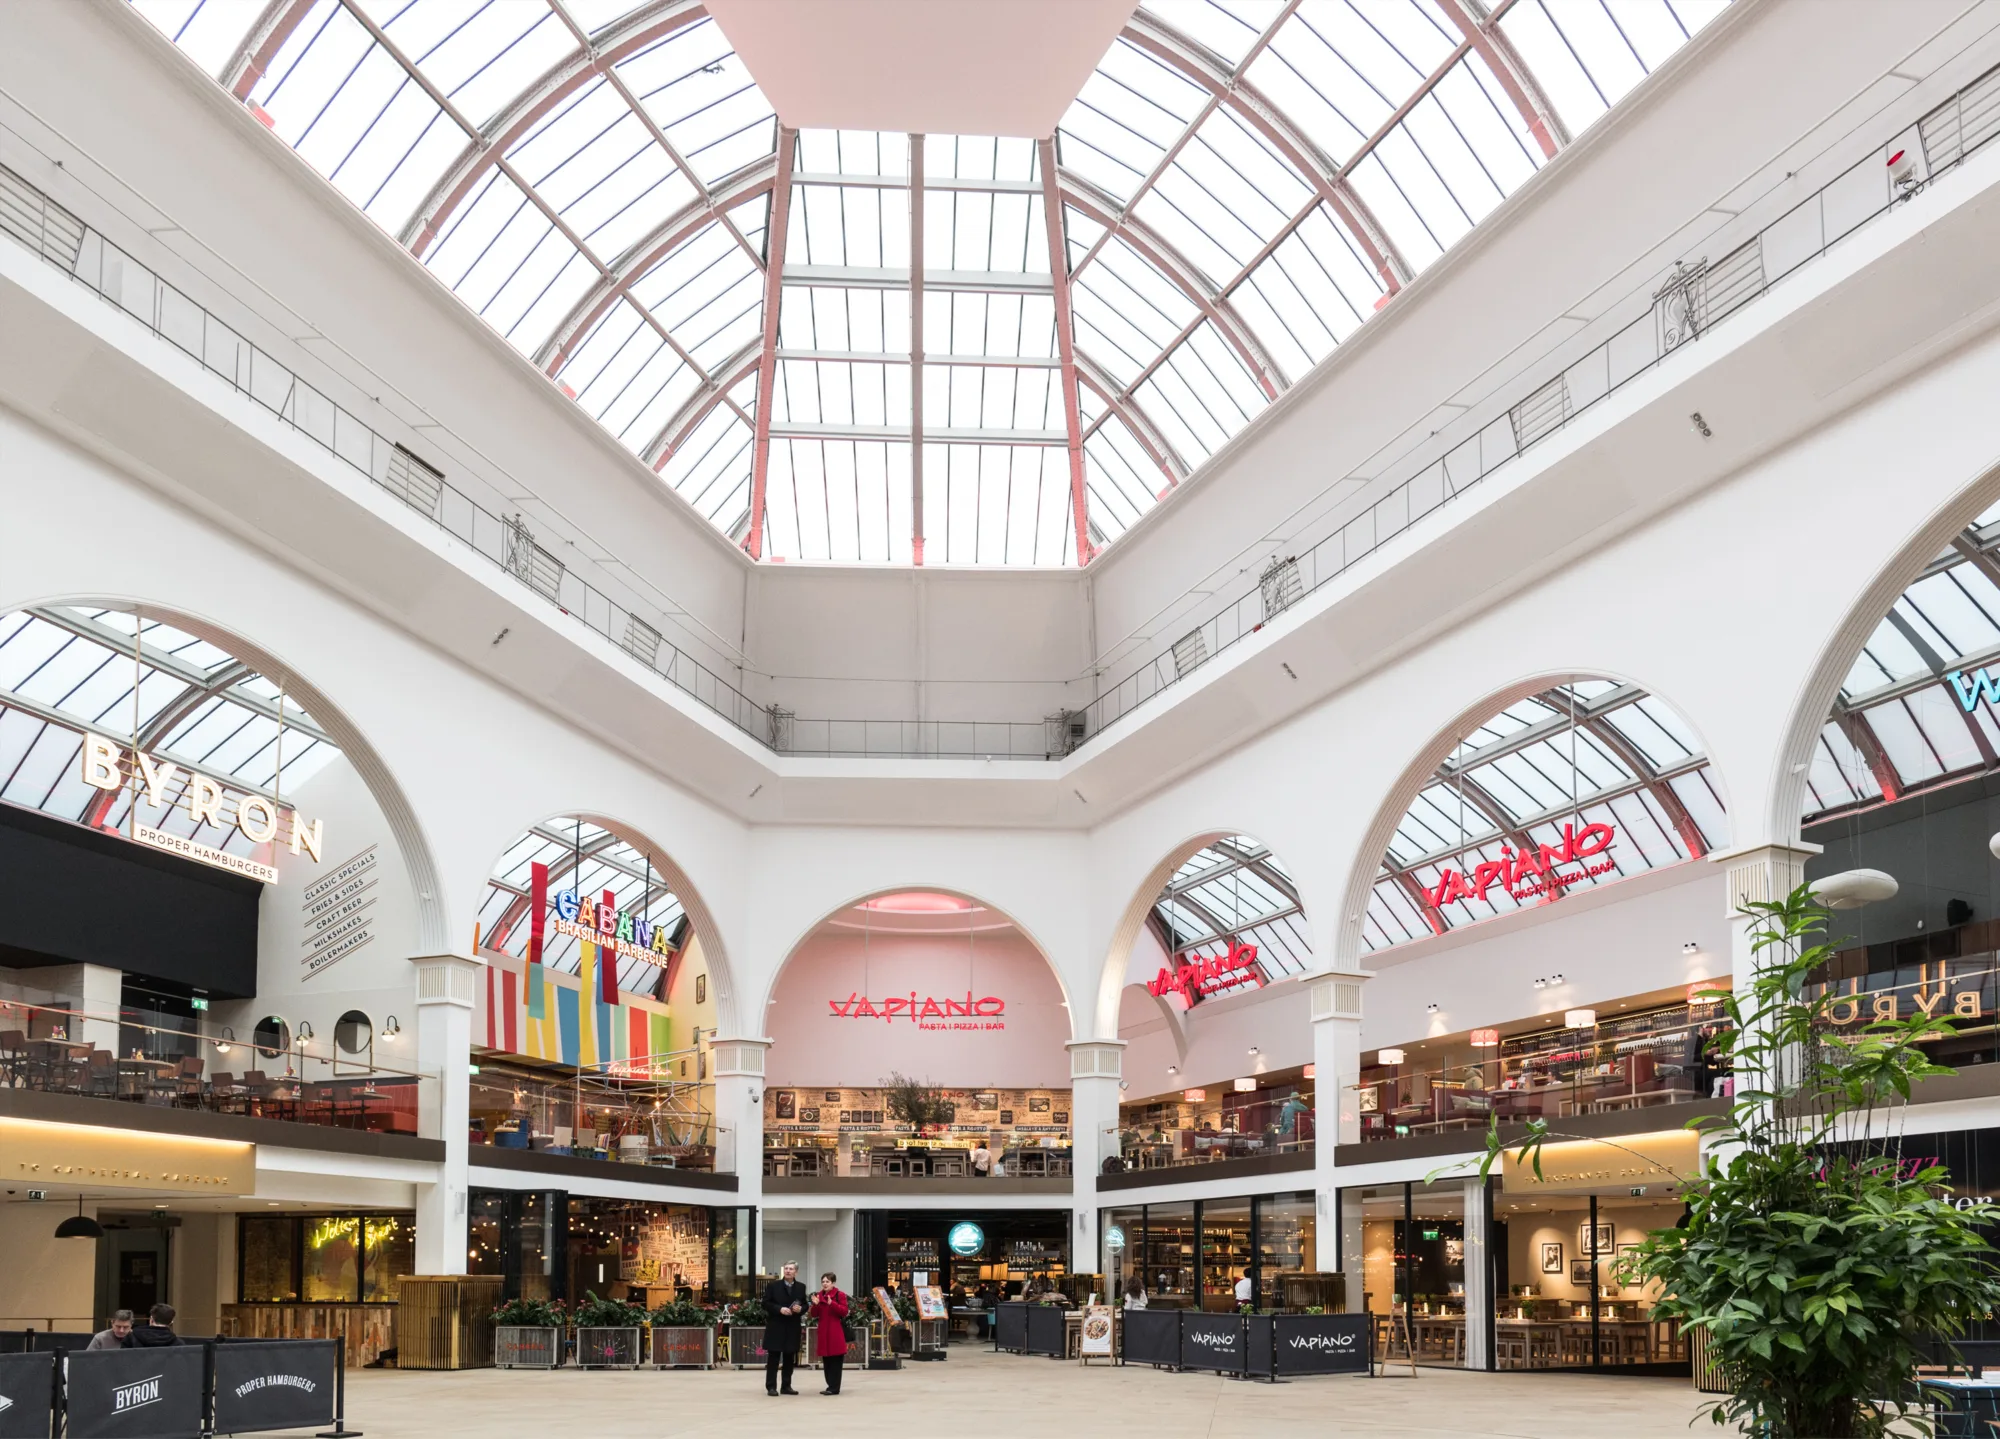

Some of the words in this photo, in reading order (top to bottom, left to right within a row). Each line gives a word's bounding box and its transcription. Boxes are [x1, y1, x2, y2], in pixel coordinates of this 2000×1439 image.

[82, 732, 324, 864] BYRON
[140, 828, 190, 853] PROPER
[194, 842, 273, 879] HAMBURGERS
[305, 877, 337, 900] CLASSIC
[338, 853, 376, 880] SPECIALS
[1513, 883, 1544, 900] PASTA
[1553, 872, 1583, 889] PIZZA
[1590, 860, 1615, 878] BAR
[311, 897, 333, 915] FRIES
[341, 879, 364, 896] SIDES
[316, 911, 340, 930] CRAFT
[342, 898, 362, 914] BEER
[313, 916, 362, 949] MILKSHAKES
[556, 889, 668, 955] CABANA
[556, 920, 615, 951] BRASILIAN
[309, 930, 368, 970] BOILERMAKERS
[919, 1023, 947, 1031] PASTA
[954, 1023, 979, 1031] PIZZA
[986, 1023, 1005, 1031] BAR
[19, 1162, 40, 1171] TO
[53, 1164, 151, 1180] CATHEDRAL
[116, 1380, 159, 1410] BYRON
[235, 1377, 266, 1398] PROPER
[267, 1375, 316, 1393] HAMBURGERS
